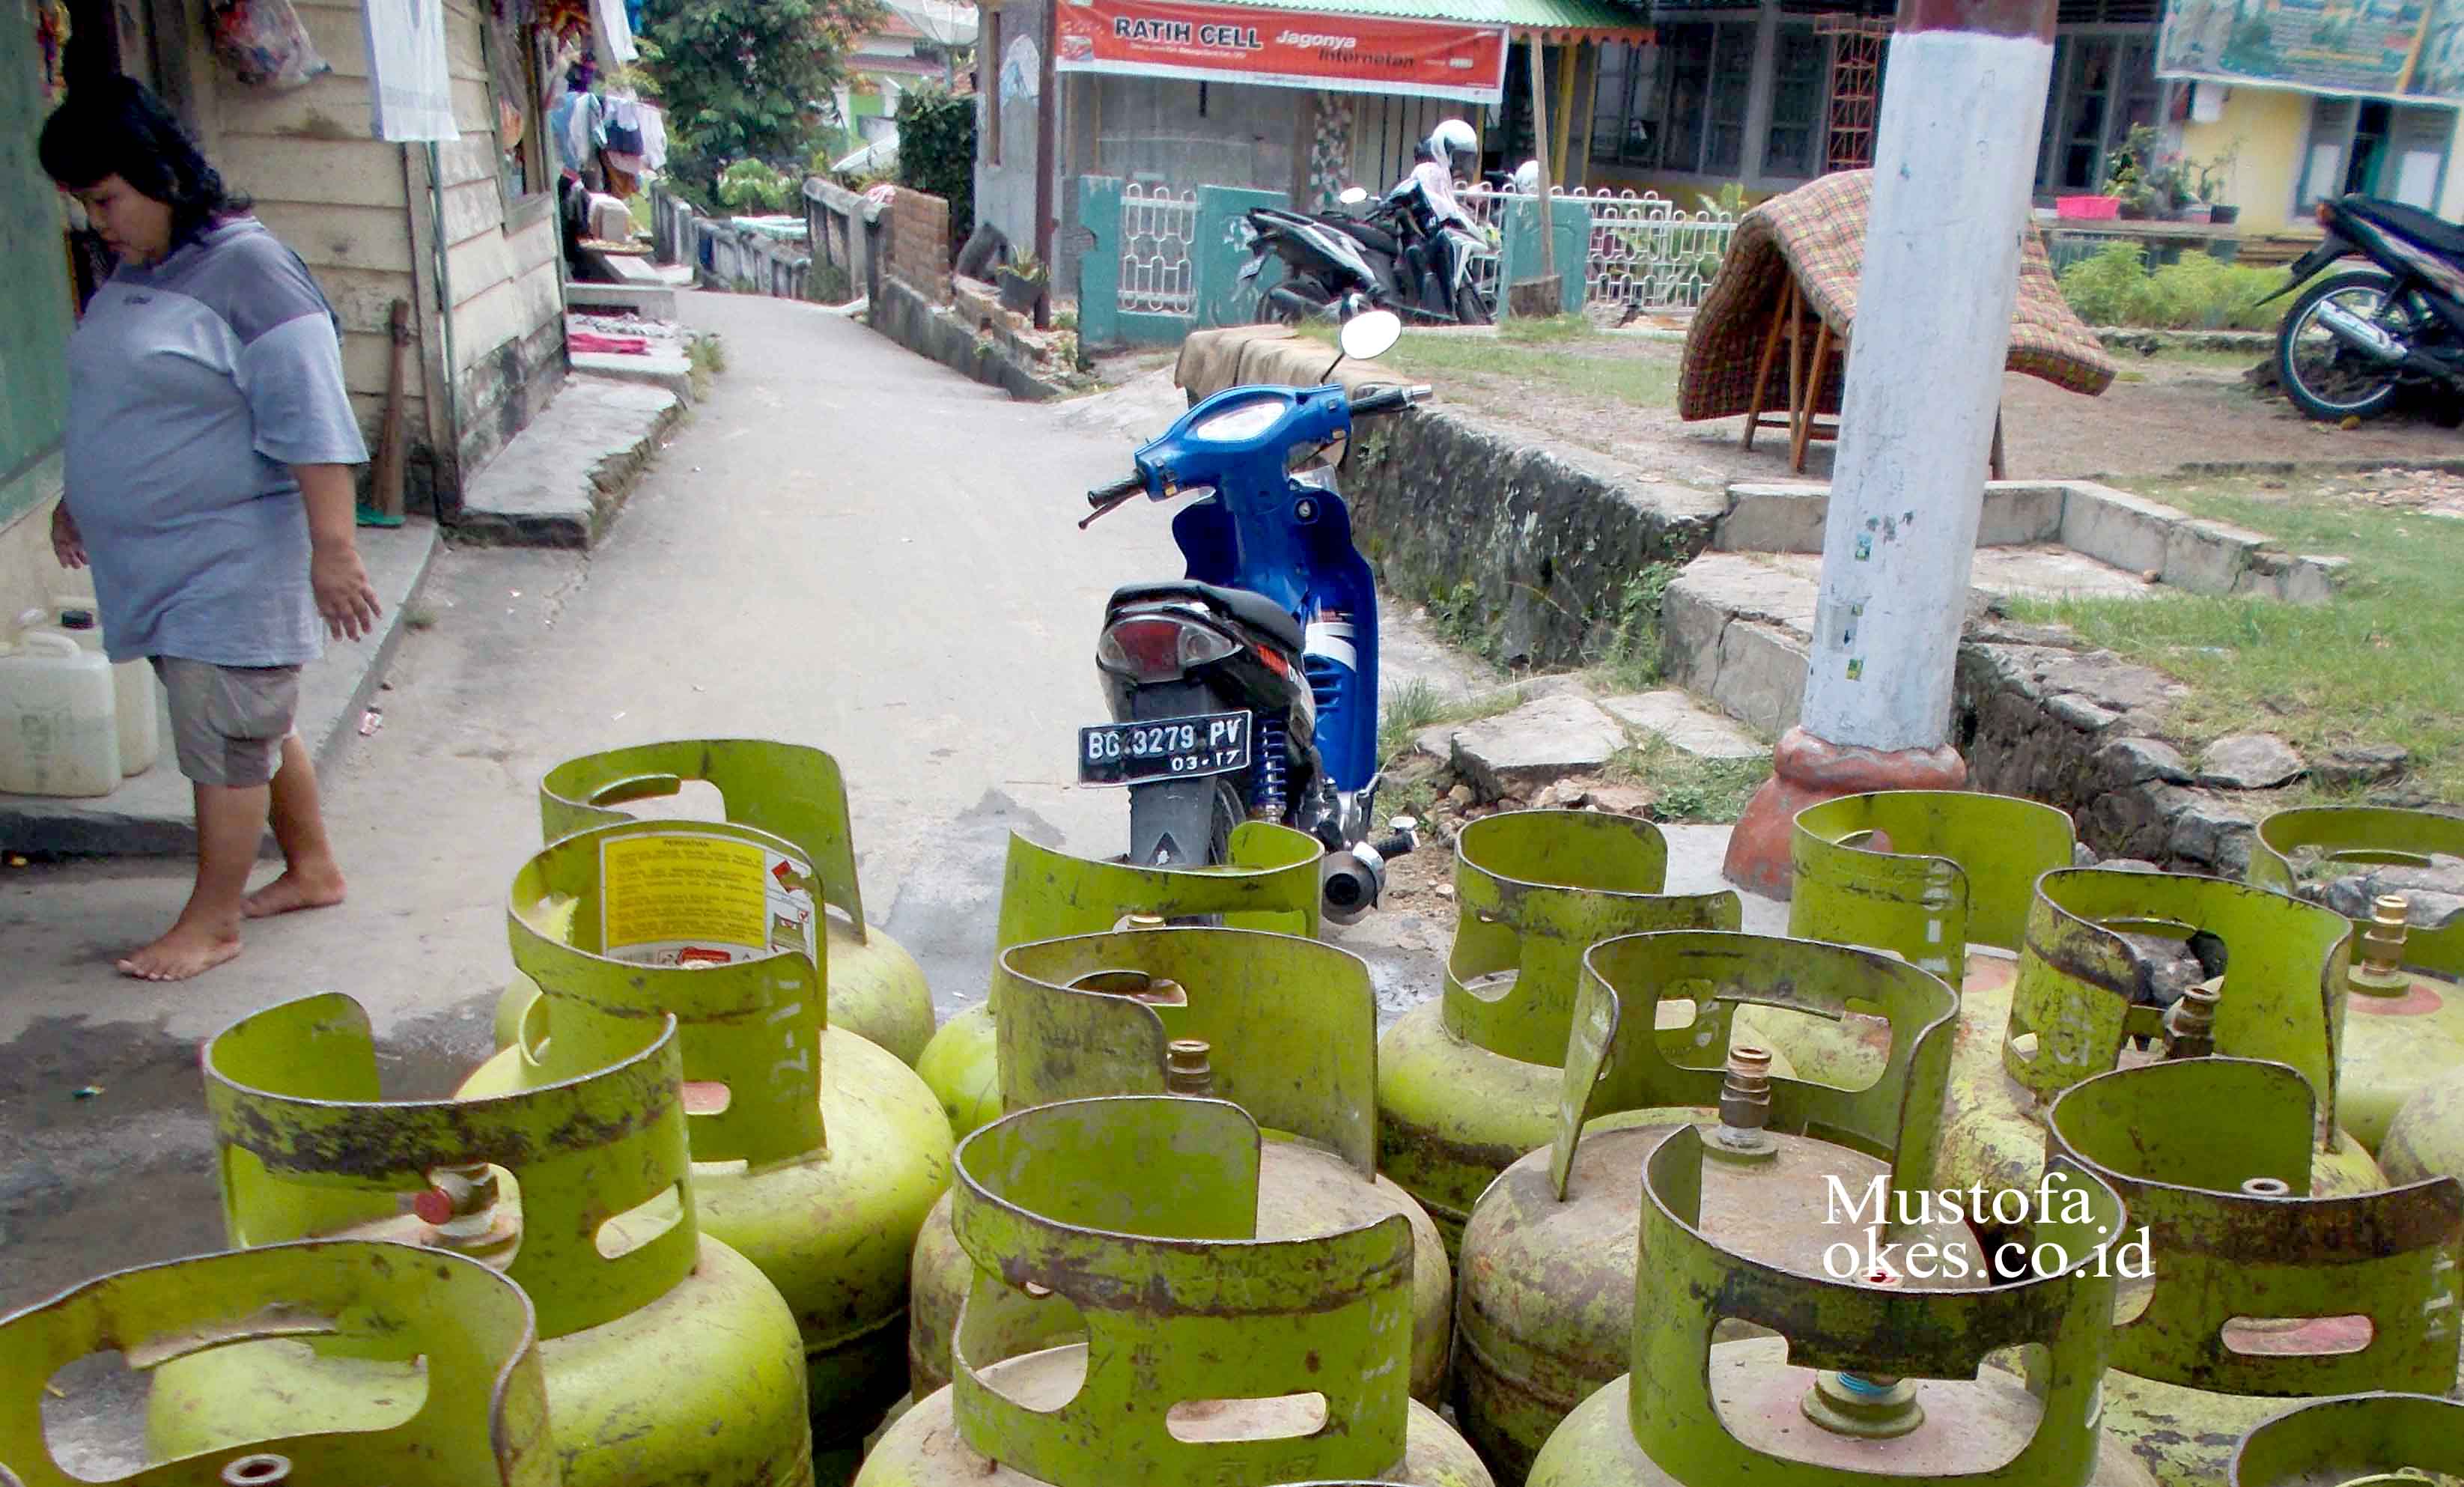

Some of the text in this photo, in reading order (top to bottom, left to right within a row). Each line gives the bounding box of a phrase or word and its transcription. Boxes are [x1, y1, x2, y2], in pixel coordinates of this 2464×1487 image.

[1114, 16, 1263, 49] RATIH CELL
[1275, 29, 1357, 49] Jagonya
[1089, 717, 1243, 759] BG 3279 PV
